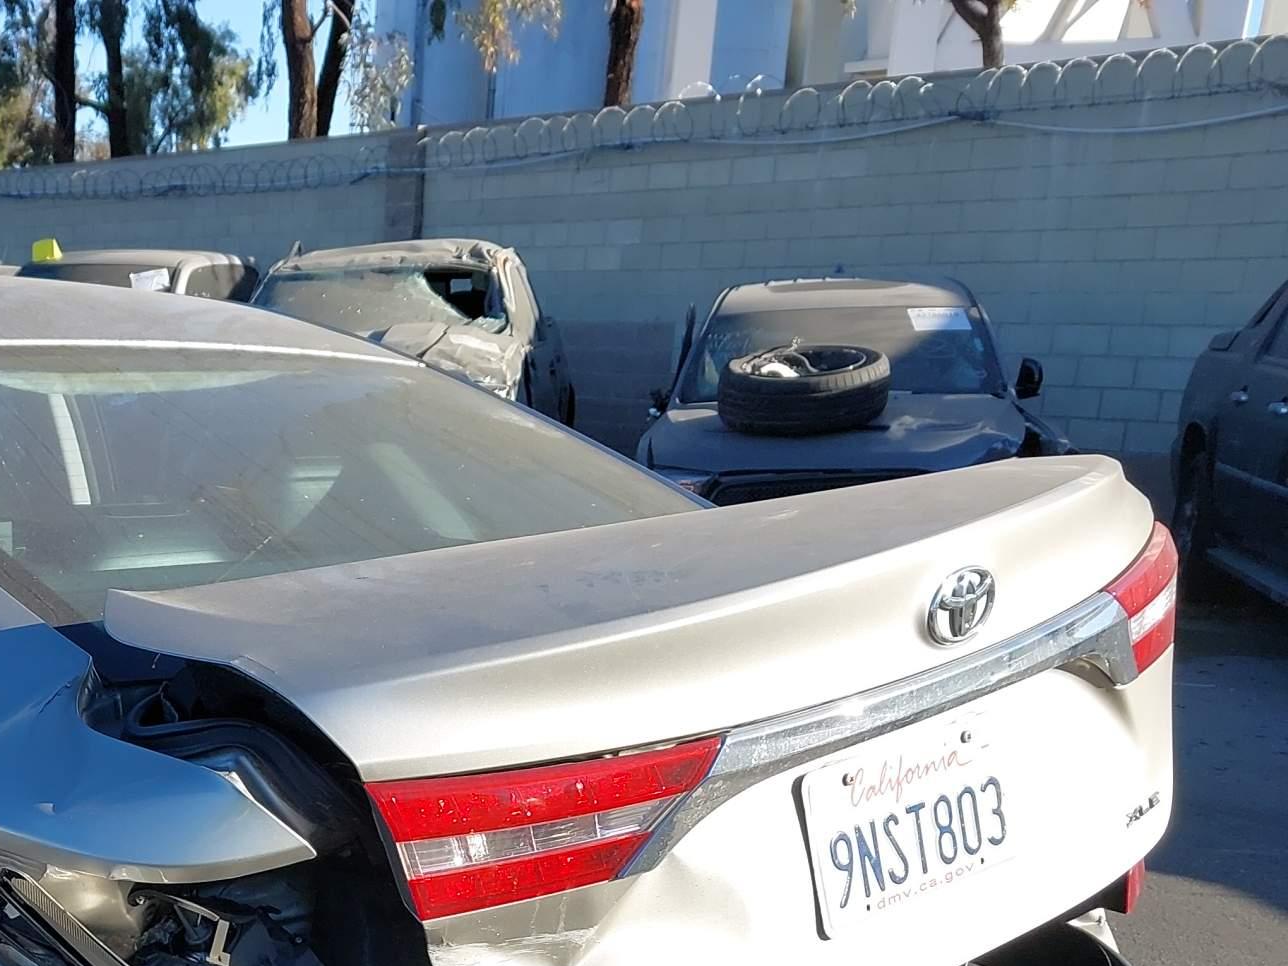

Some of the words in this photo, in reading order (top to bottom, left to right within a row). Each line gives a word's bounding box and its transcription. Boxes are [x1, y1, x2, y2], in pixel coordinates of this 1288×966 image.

[849, 749, 973, 808] California
[1124, 790, 1161, 829] XLE
[829, 775, 1007, 909] 9NST803
[876, 862, 975, 910] dmv.ca.gov
